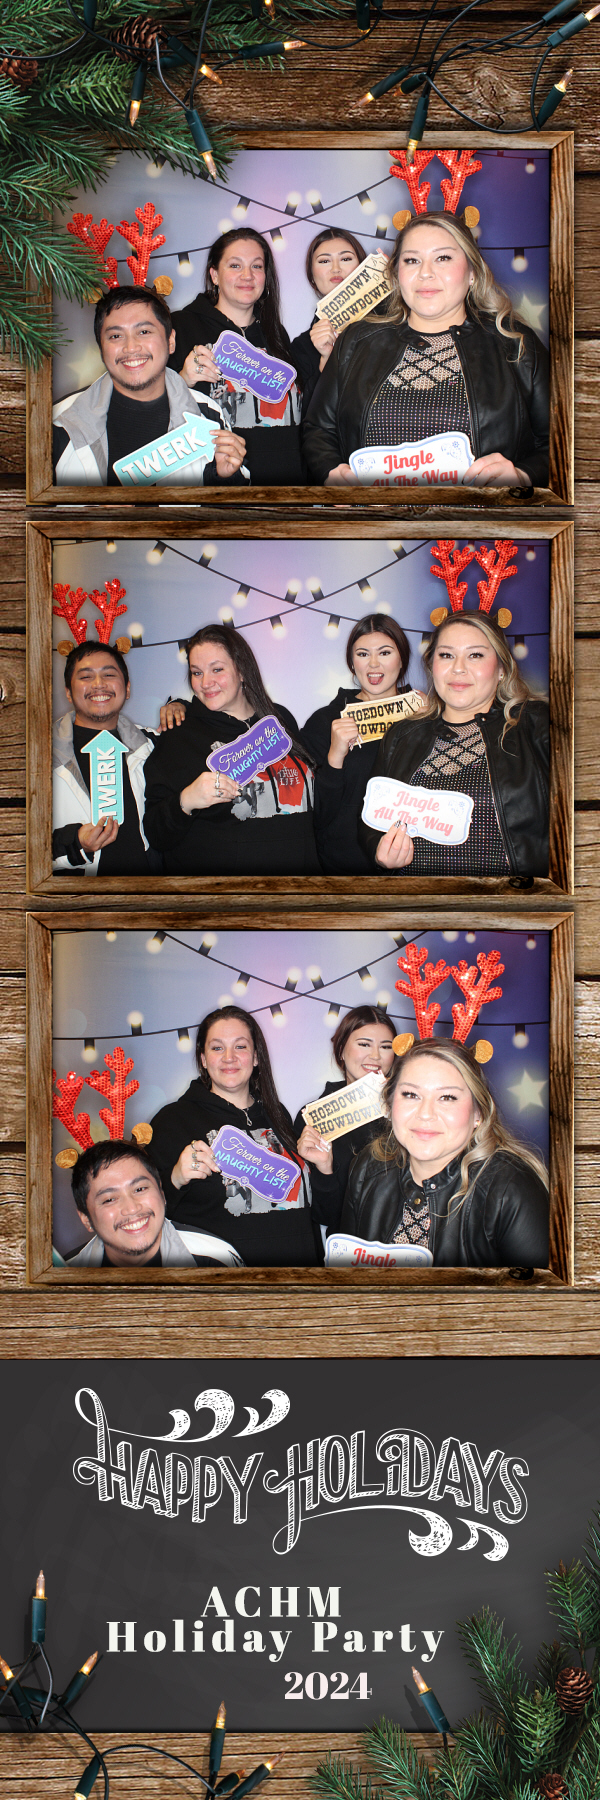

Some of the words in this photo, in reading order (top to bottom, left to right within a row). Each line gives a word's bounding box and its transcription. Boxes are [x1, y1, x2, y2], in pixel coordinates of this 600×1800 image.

[321, 269, 372, 319] HOEDOWN
[215, 354, 262, 381] NAUGHTY
[261, 375, 284, 391] LIST
[221, 341, 261, 369] Forever
[260, 366, 273, 376] on
[273, 370, 287, 383] the
[121, 426, 208, 485] TWERK
[383, 450, 435, 475] Jingle
[394, 474, 419, 486] The
[421, 469, 458, 485] Way
[218, 743, 254, 773] Forever
[254, 735, 265, 747] on
[264, 726, 277, 738] the
[263, 732, 281, 751] LIST
[96, 746, 118, 820] TWERK
[280, 776, 301, 786] LIFE
[392, 791, 440, 812] Jingle
[374, 806, 394, 820] All
[397, 810, 419, 825] The
[422, 815, 454, 837] Way
[308, 1085, 367, 1124] HOEDOWN
[215, 1150, 264, 1178] NAUGHTY
[263, 1173, 287, 1189] LIST
[221, 1136, 262, 1165] Forever
[262, 1163, 275, 1173] on
[275, 1167, 290, 1181] the
[351, 1248, 397, 1267] Jingle
